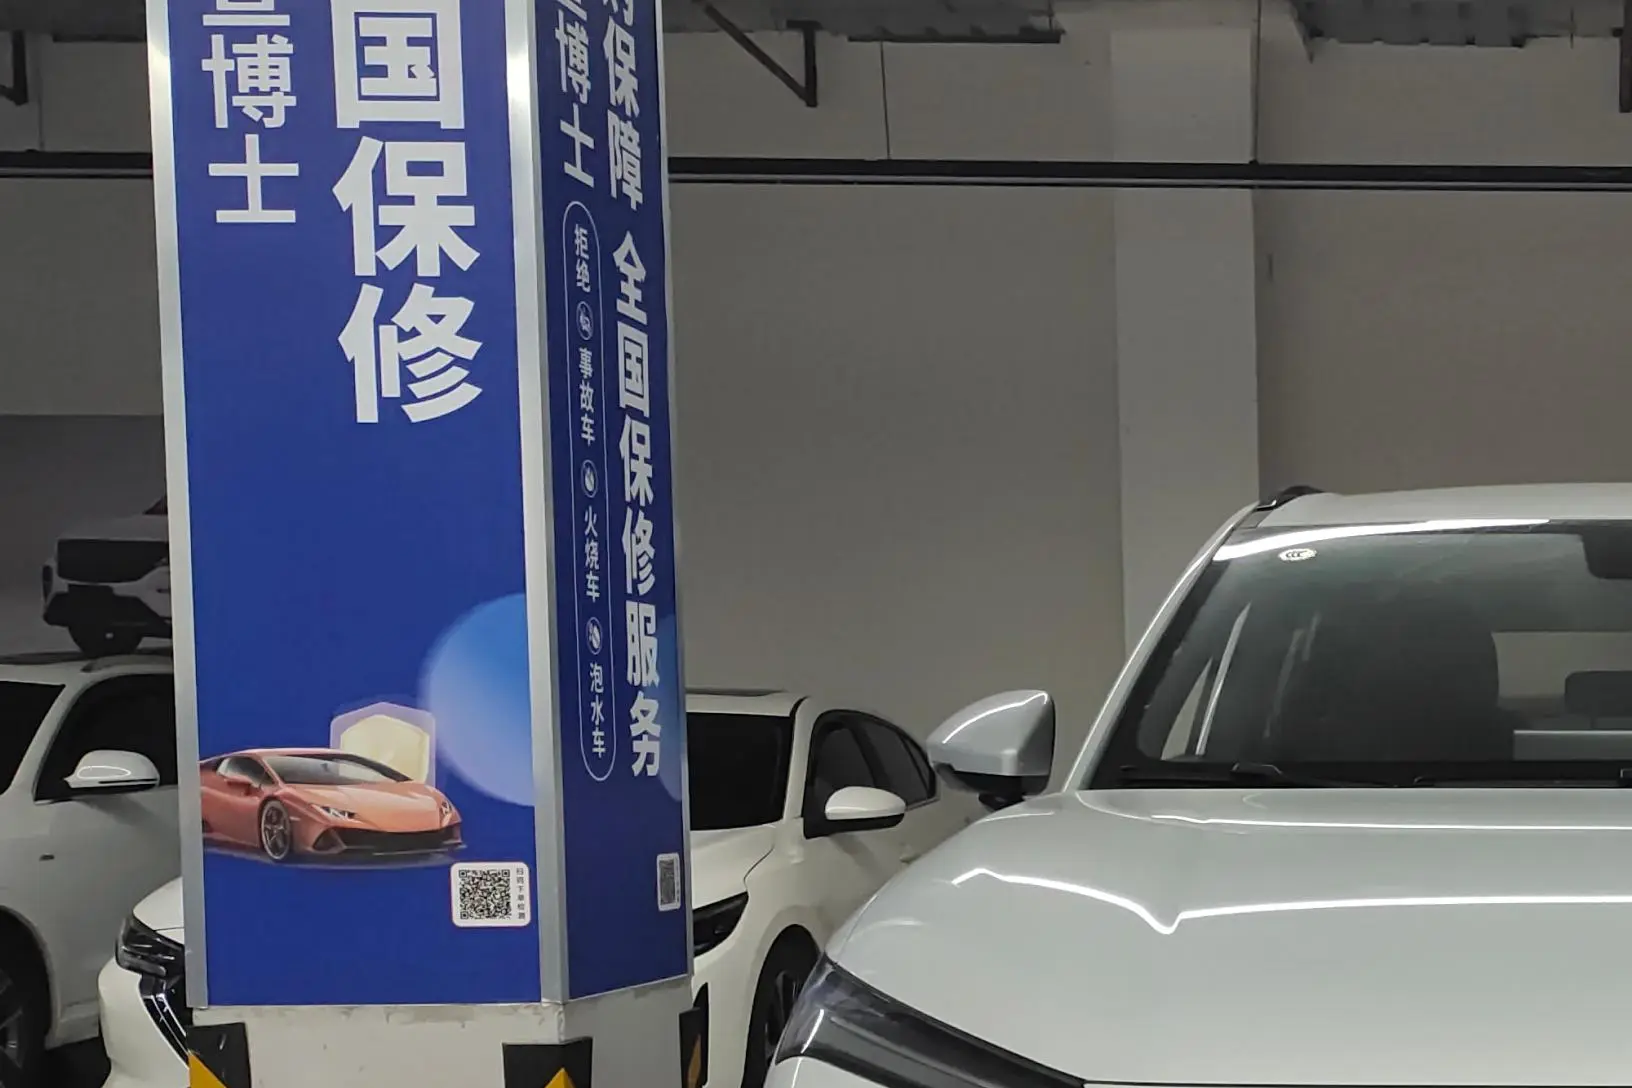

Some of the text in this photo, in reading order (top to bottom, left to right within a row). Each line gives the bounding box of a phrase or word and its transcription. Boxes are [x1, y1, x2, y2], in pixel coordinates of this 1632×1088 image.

[201, 0, 299, 224] 博士
[554, 0, 595, 188] 博士
[331, 0, 483, 424] 国保修
[578, 347, 596, 446] 事故车
[602, 0, 662, 777] 保障 全国保修服务
[584, 505, 601, 603] 火烧车
[588, 662, 607, 759] 泡水车
